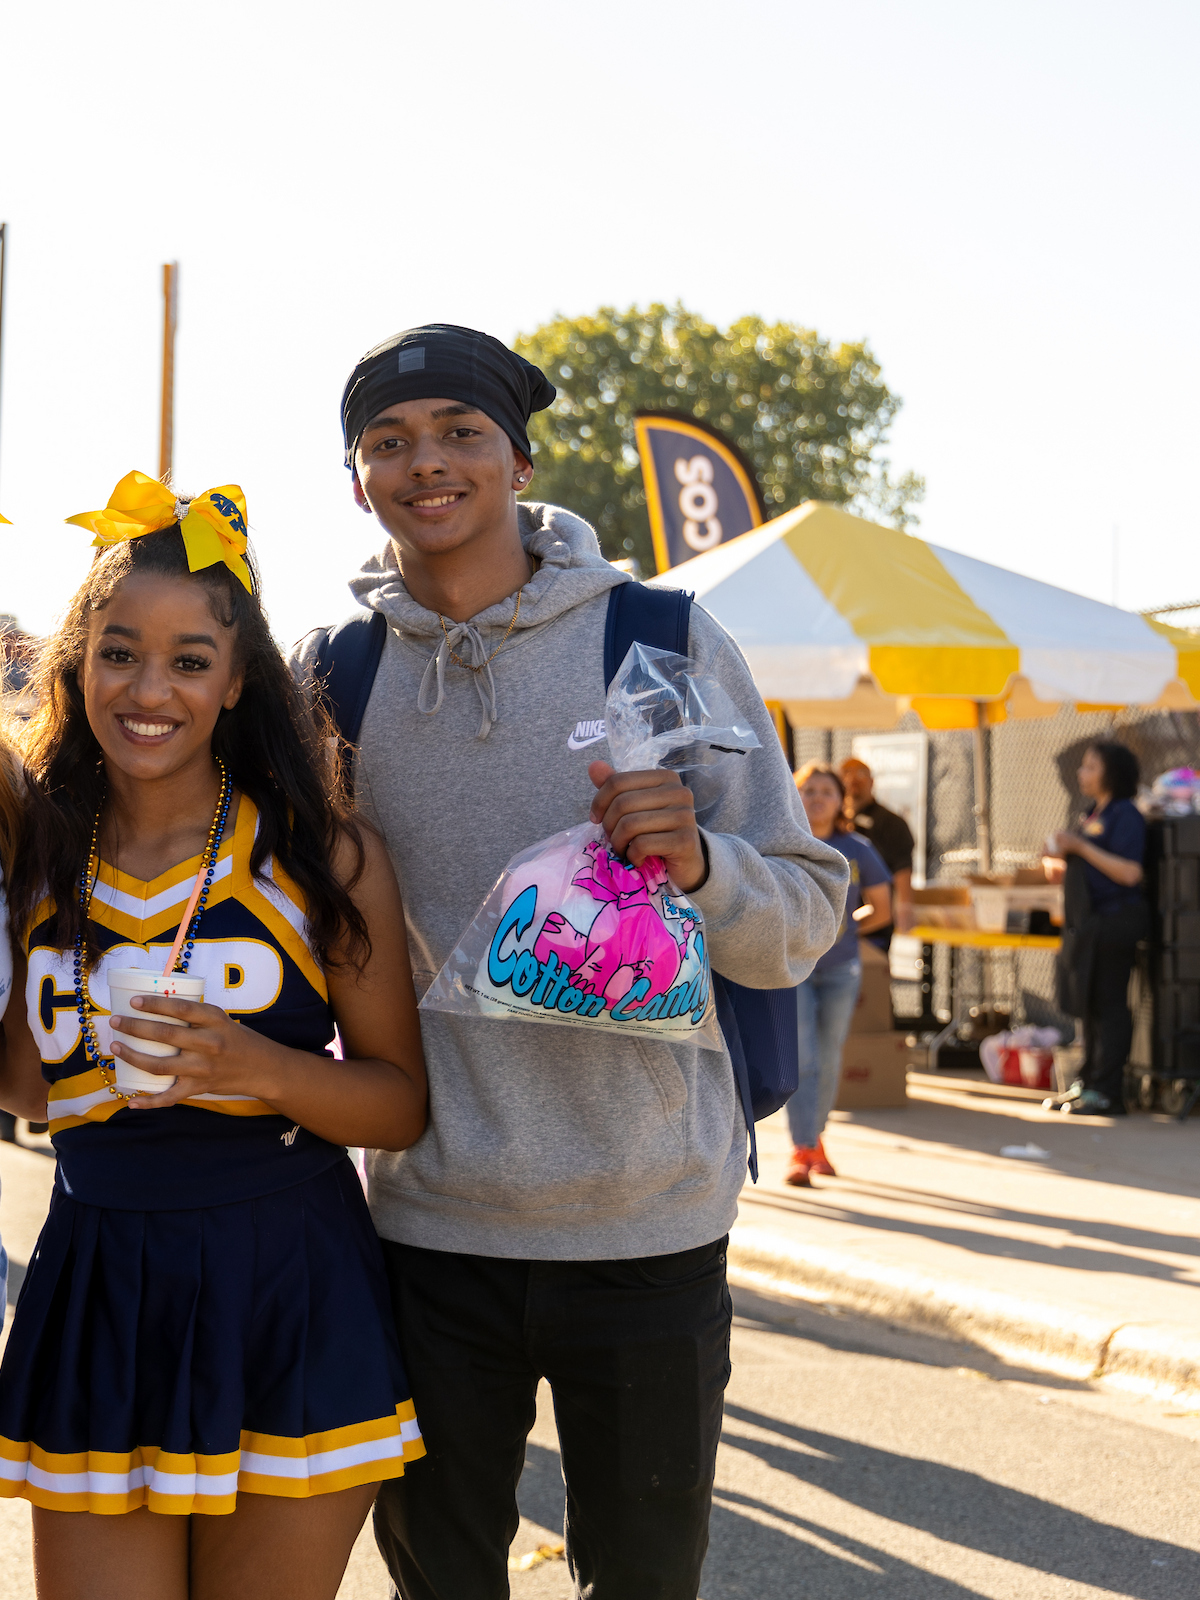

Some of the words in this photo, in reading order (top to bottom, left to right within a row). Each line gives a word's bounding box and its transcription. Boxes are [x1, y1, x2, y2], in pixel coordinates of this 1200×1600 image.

[675, 455, 722, 551] COS
[574, 719, 605, 738] NIKE
[487, 884, 608, 1018] Cotton
